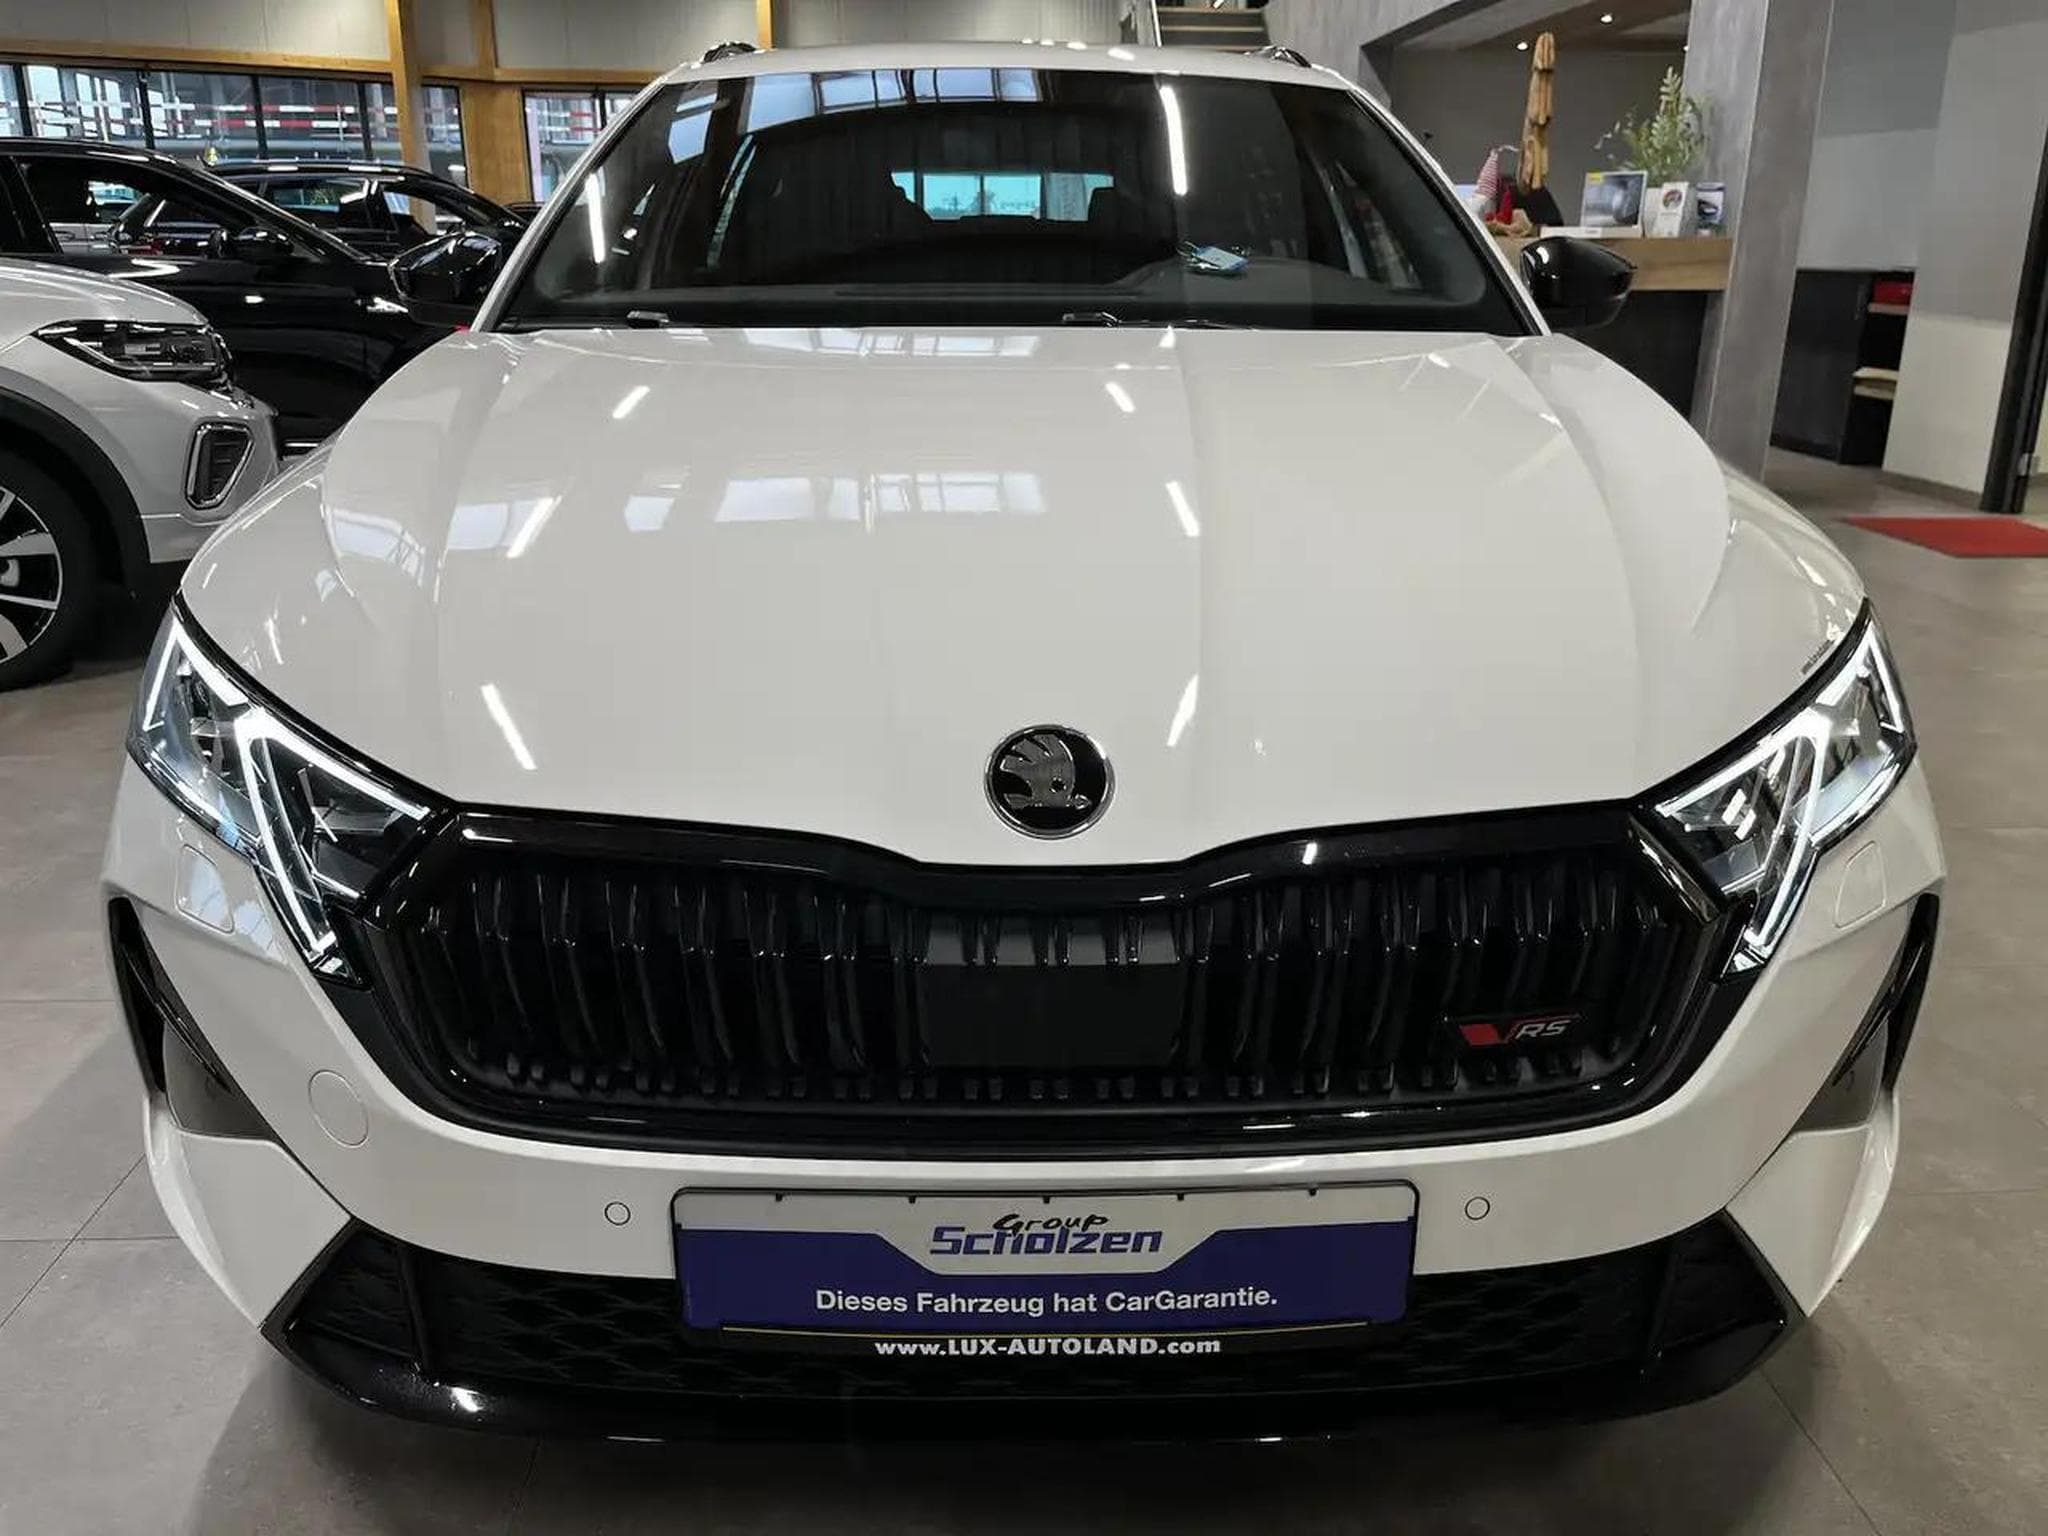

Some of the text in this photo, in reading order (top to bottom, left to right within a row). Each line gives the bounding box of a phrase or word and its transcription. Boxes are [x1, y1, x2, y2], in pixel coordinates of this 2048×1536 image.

[992, 1213, 1110, 1235] Group
[930, 1226, 1163, 1255] Scholzen
[815, 1286, 1278, 1317] Dieses Fahrzeug hat CarGarantie.
[874, 1338, 1221, 1356] www.LUX-AUTOLAND.com
